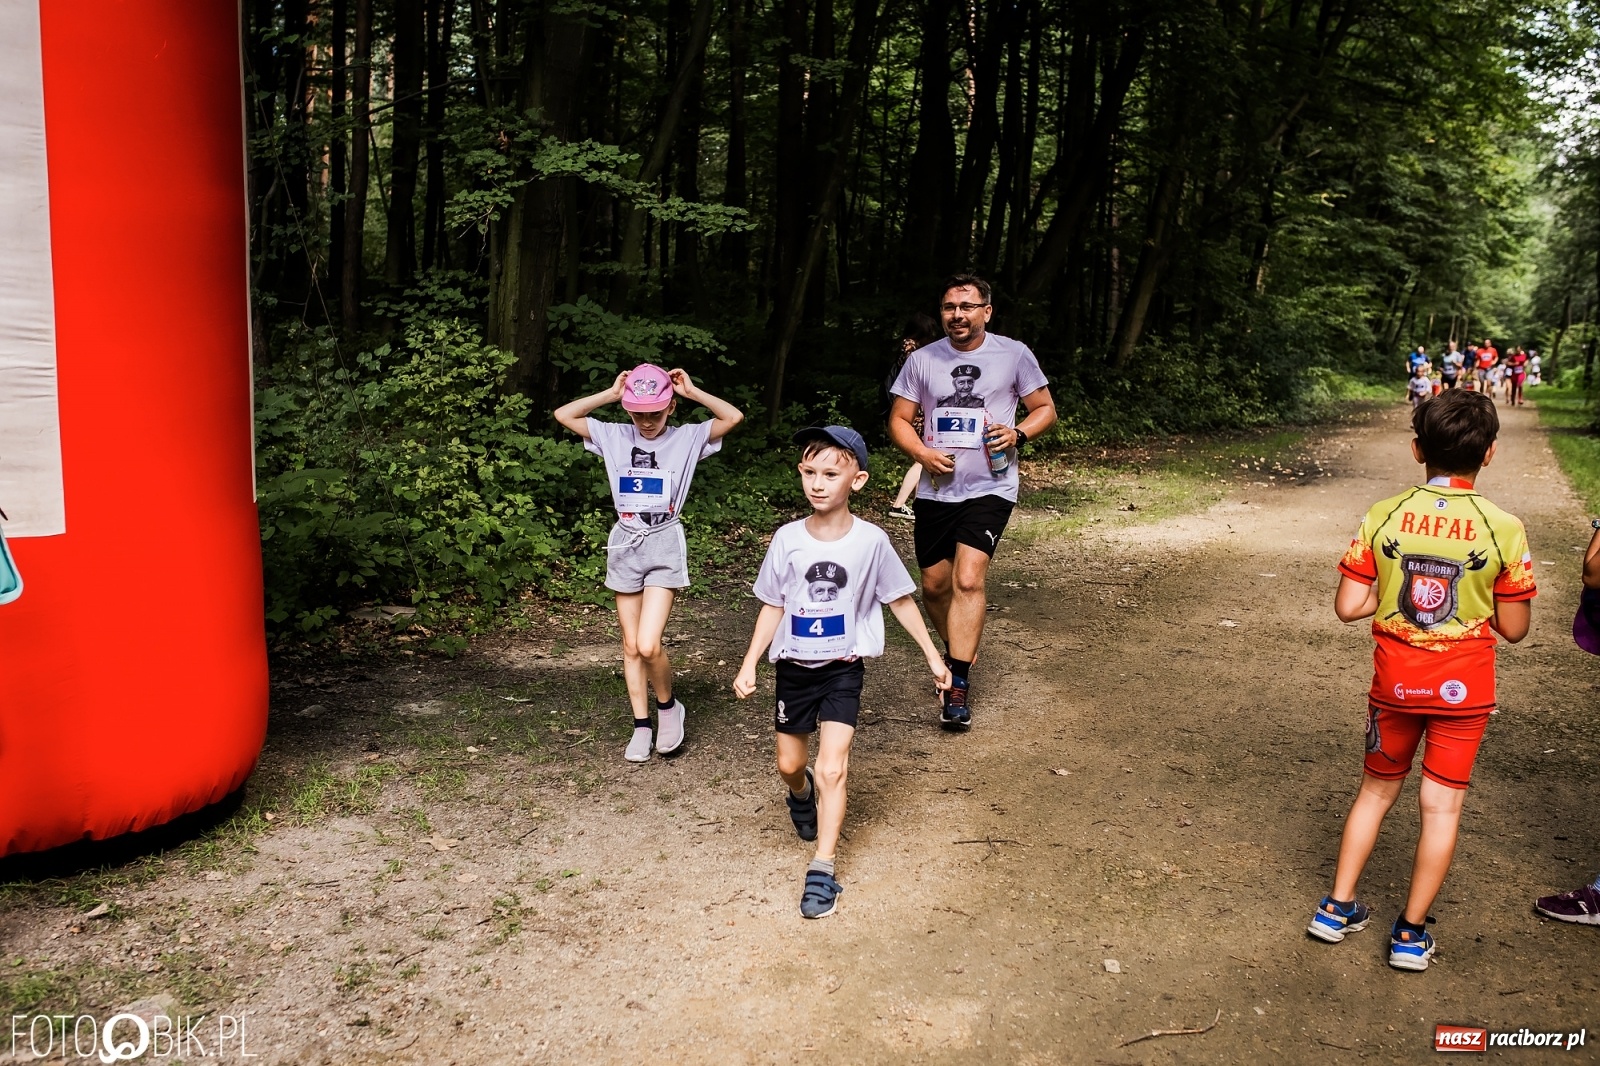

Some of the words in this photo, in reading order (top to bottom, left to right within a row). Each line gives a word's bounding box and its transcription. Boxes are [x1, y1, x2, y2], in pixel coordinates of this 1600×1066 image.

[950, 418, 960, 431] 2
[632, 478, 643, 492] 3
[1400, 512, 1477, 541] RAFAŁ
[1416, 612, 1434, 624] OCR
[809, 618, 824, 636] 4
[1405, 688, 1434, 696] MebRaj
